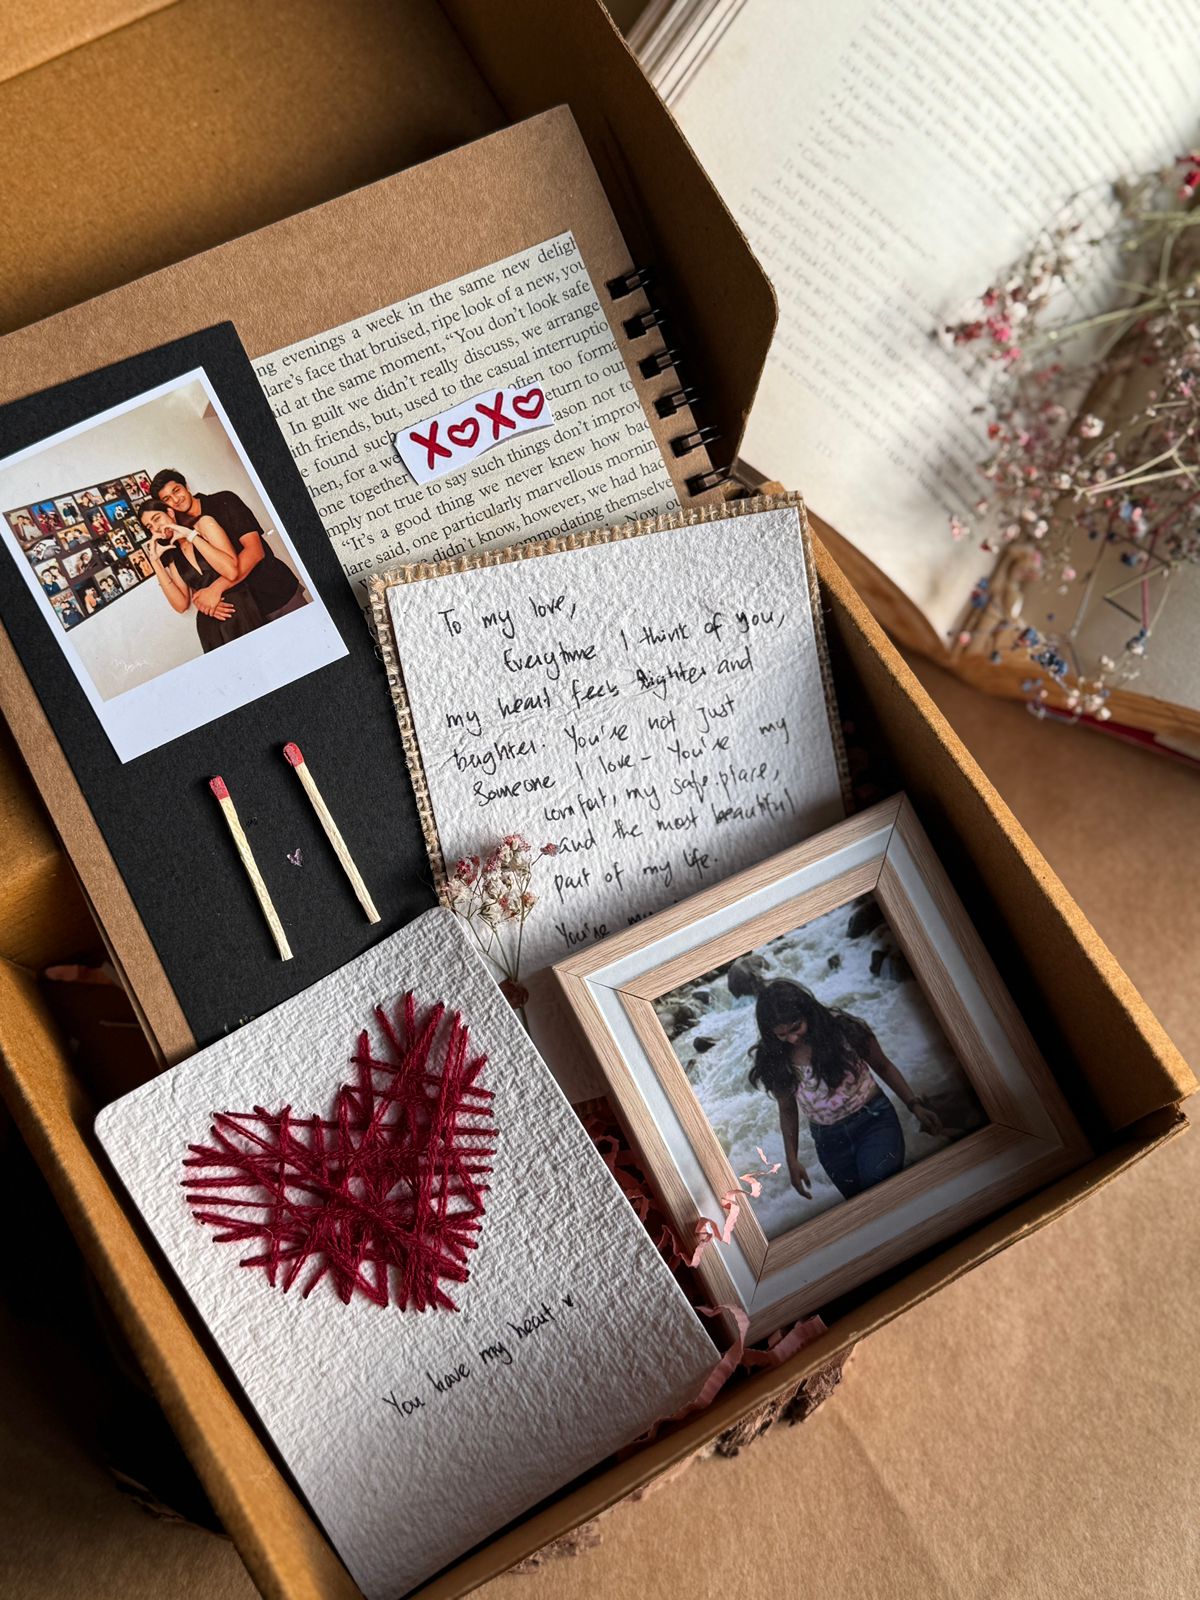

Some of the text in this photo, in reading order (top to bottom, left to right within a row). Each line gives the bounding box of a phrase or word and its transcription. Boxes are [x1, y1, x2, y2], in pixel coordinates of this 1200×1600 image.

[281, 334, 345, 366] evenings
[351, 328, 361, 339] a
[365, 308, 404, 332] week
[407, 302, 424, 316] in
[429, 291, 453, 307] the
[458, 274, 496, 296] same
[501, 258, 529, 278] new
[294, 395, 310, 409] at
[311, 386, 336, 402] the
[338, 369, 377, 391] same
[379, 342, 446, 375] moment,
[445, 325, 484, 343] “You
[488, 306, 526, 330] don’t
[525, 292, 560, 314] look
[561, 279, 590, 300] safe
[305, 362, 336, 381] face
[338, 348, 369, 367] that
[368, 321, 430, 354] bruised,
[431, 311, 461, 330] ripe
[460, 295, 495, 318] look
[496, 285, 511, 303] of
[514, 286, 524, 296] a
[525, 271, 560, 292] new,
[287, 421, 308, 435] In
[311, 404, 345, 429] guilt
[347, 396, 369, 411] we
[373, 375, 417, 401] didn’t
[419, 358, 457, 382] really
[464, 337, 519, 364] discuss,
[521, 325, 542, 339] we
[314, 419, 371, 449] friends,
[370, 407, 403, 424] but,
[403, 387, 439, 411] used
[440, 384, 456, 397] to
[459, 373, 483, 389] the
[486, 350, 530, 378] casual
[531, 320, 608, 360] interruptio
[548, 360, 572, 376] too
[583, 372, 599, 384] to
[591, 387, 616, 405] not
[313, 443, 359, 473] found
[343, 467, 365, 484] for
[368, 463, 378, 474] a
[348, 466, 408, 504] together
[365, 503, 392, 521] not
[393, 490, 424, 509] true
[425, 483, 441, 496] to
[444, 472, 466, 488] say
[470, 455, 505, 478] such
[506, 438, 550, 463] things
[553, 420, 590, 443] don’t
[341, 532, 375, 551] “It’s
[380, 528, 390, 539] a
[394, 507, 432, 536] good
[435, 492, 475, 515] thing
[478, 482, 499, 496] we
[504, 463, 543, 487] never
[547, 446, 584, 468] knew
[589, 431, 619, 451] how
[375, 541, 410, 564] said,
[412, 531, 439, 548] one
[441, 495, 521, 540] particularly
[525, 462, 603, 501] marvellous
[432, 537, 475, 563] didn’t
[475, 521, 520, 544] know,
[520, 494, 586, 526] however,
[586, 483, 607, 497] we
[609, 466, 638, 488] had
[438, 595, 576, 639] To my love,
[620, 630, 629, 650] I
[640, 624, 689, 645] think
[704, 612, 722, 642] of
[736, 611, 785, 633] you,
[446, 646, 753, 736] my heart feels lighter and
[564, 724, 629, 755] You're
[648, 710, 676, 732] not
[575, 761, 583, 779] I
[667, 736, 731, 766] You're
[759, 717, 789, 744] my
[558, 788, 796, 855] and the most beautiful
[626, 785, 661, 811] my
[554, 848, 718, 904] part of my life.
[382, 1302, 556, 1418] You have my heart
